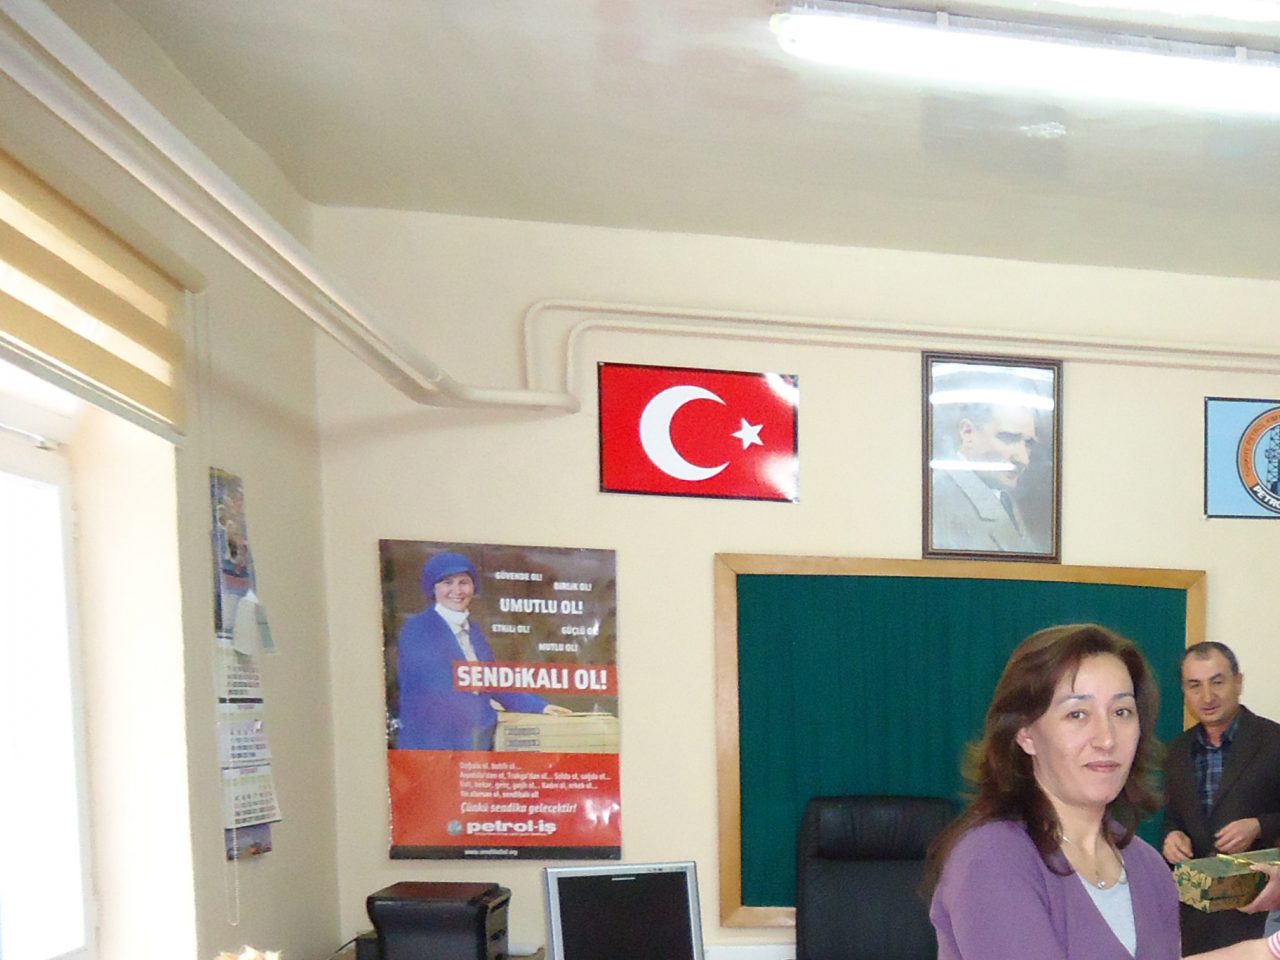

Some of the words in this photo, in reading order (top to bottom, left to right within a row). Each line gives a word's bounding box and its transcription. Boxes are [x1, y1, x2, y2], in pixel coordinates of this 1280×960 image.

[500, 598, 557, 613] UMUTLU
[560, 600, 583, 614] OL!
[574, 668, 608, 690] OL!
[466, 819, 557, 835] petrol-iş
